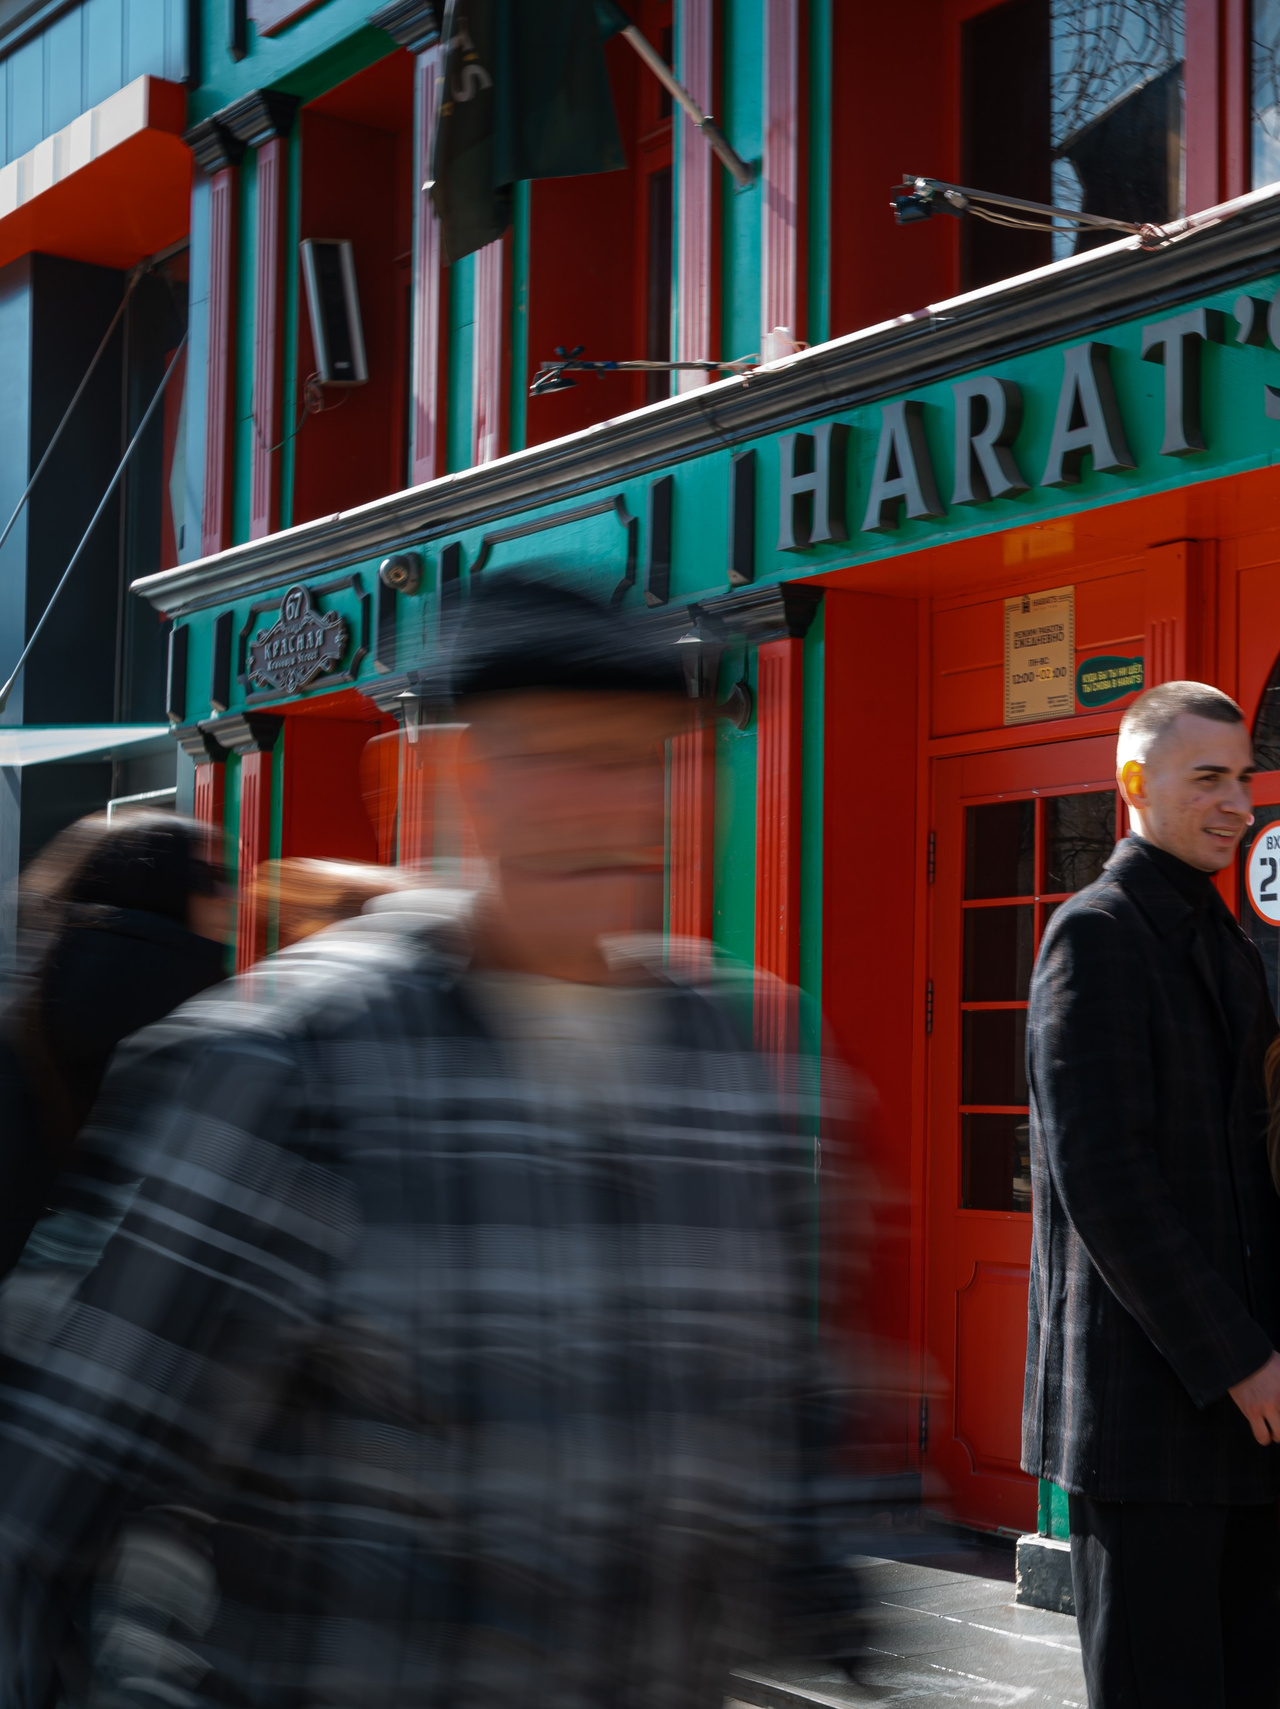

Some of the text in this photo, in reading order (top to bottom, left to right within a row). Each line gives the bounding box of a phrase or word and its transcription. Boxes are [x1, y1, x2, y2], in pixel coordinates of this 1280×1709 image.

[286, 591, 303, 620] 67
[264, 629, 324, 660] КРАСНАЯ
[1014, 631, 1065, 649] ЕЖЕДНЕВНО
